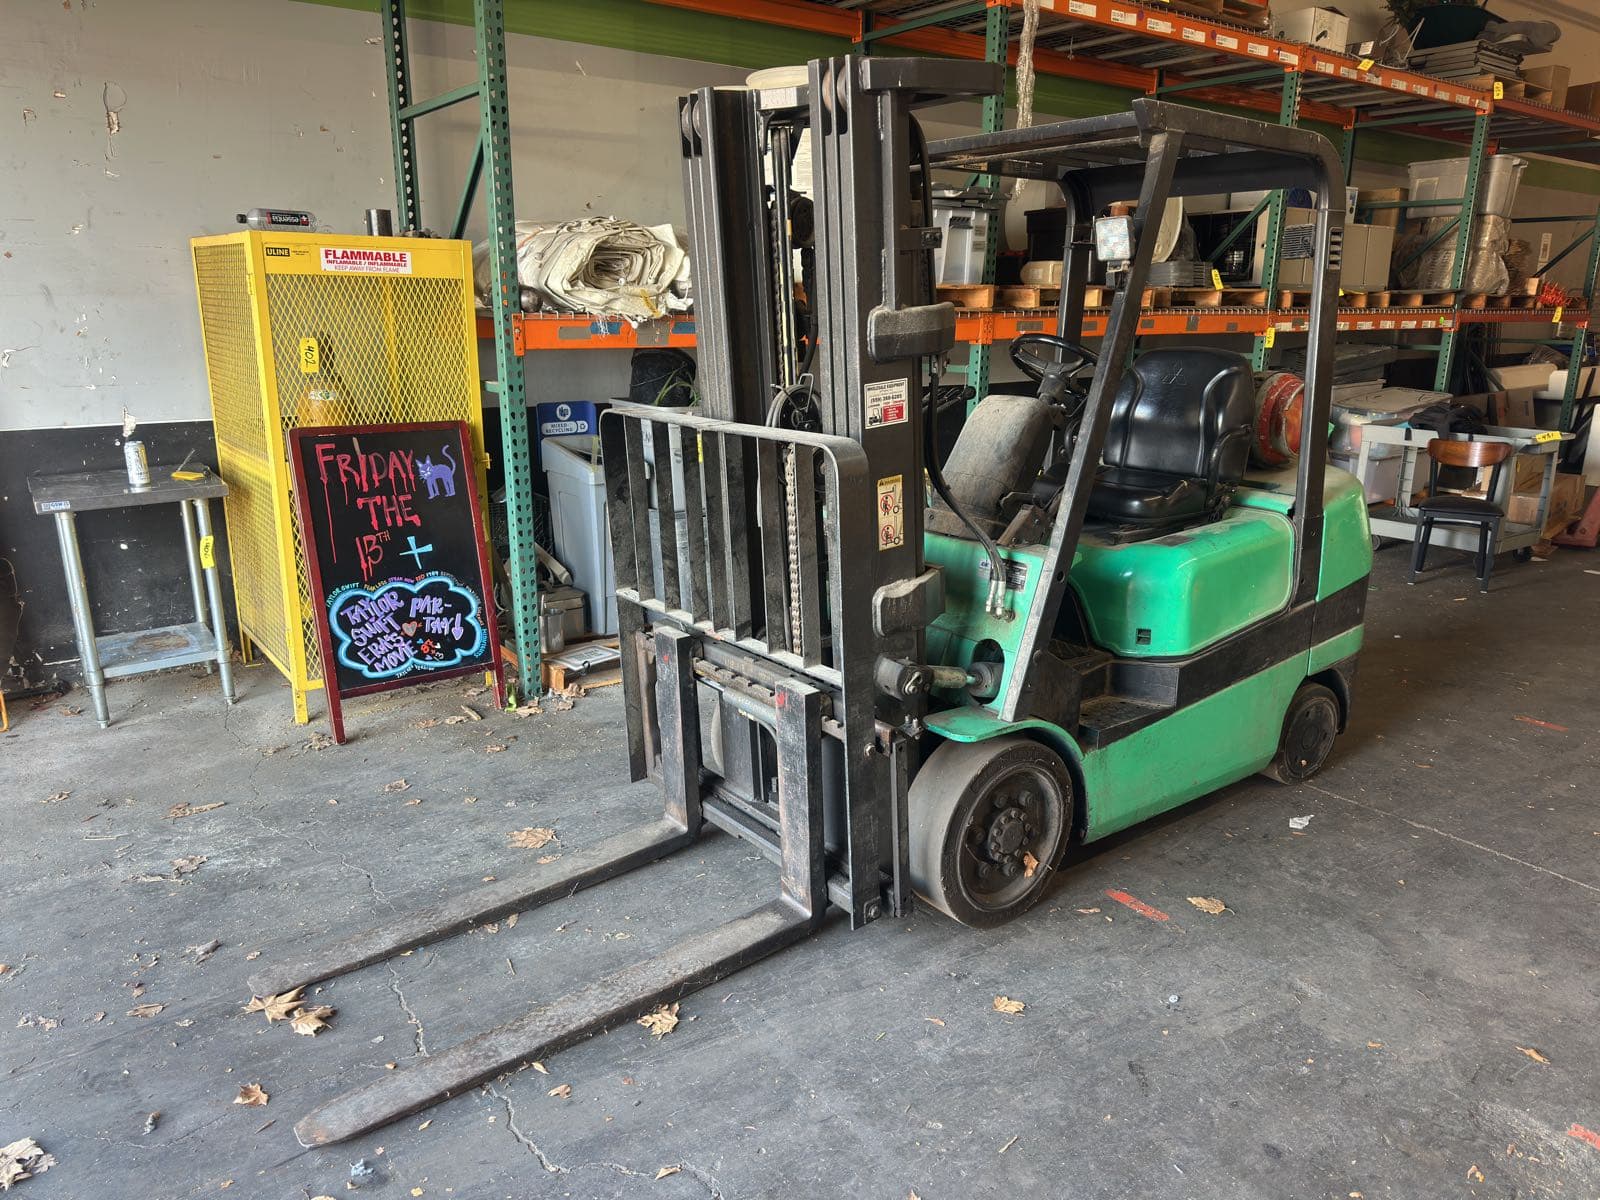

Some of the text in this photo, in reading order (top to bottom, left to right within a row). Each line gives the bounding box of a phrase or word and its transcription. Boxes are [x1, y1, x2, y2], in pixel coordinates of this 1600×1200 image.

[267, 248, 289, 256] ULINE
[324, 249, 407, 263] FLAMMABLE
[315, 443, 416, 494] FRIDAY
[356, 494, 422, 531] THE
[341, 582, 360, 592] SWIFT
[340, 591, 405, 626] TAYLOR
[350, 612, 401, 647] SWIFT
[423, 616, 455, 636] TAY
[357, 632, 406, 666] ERAS
[373, 639, 419, 673] MOVIE
